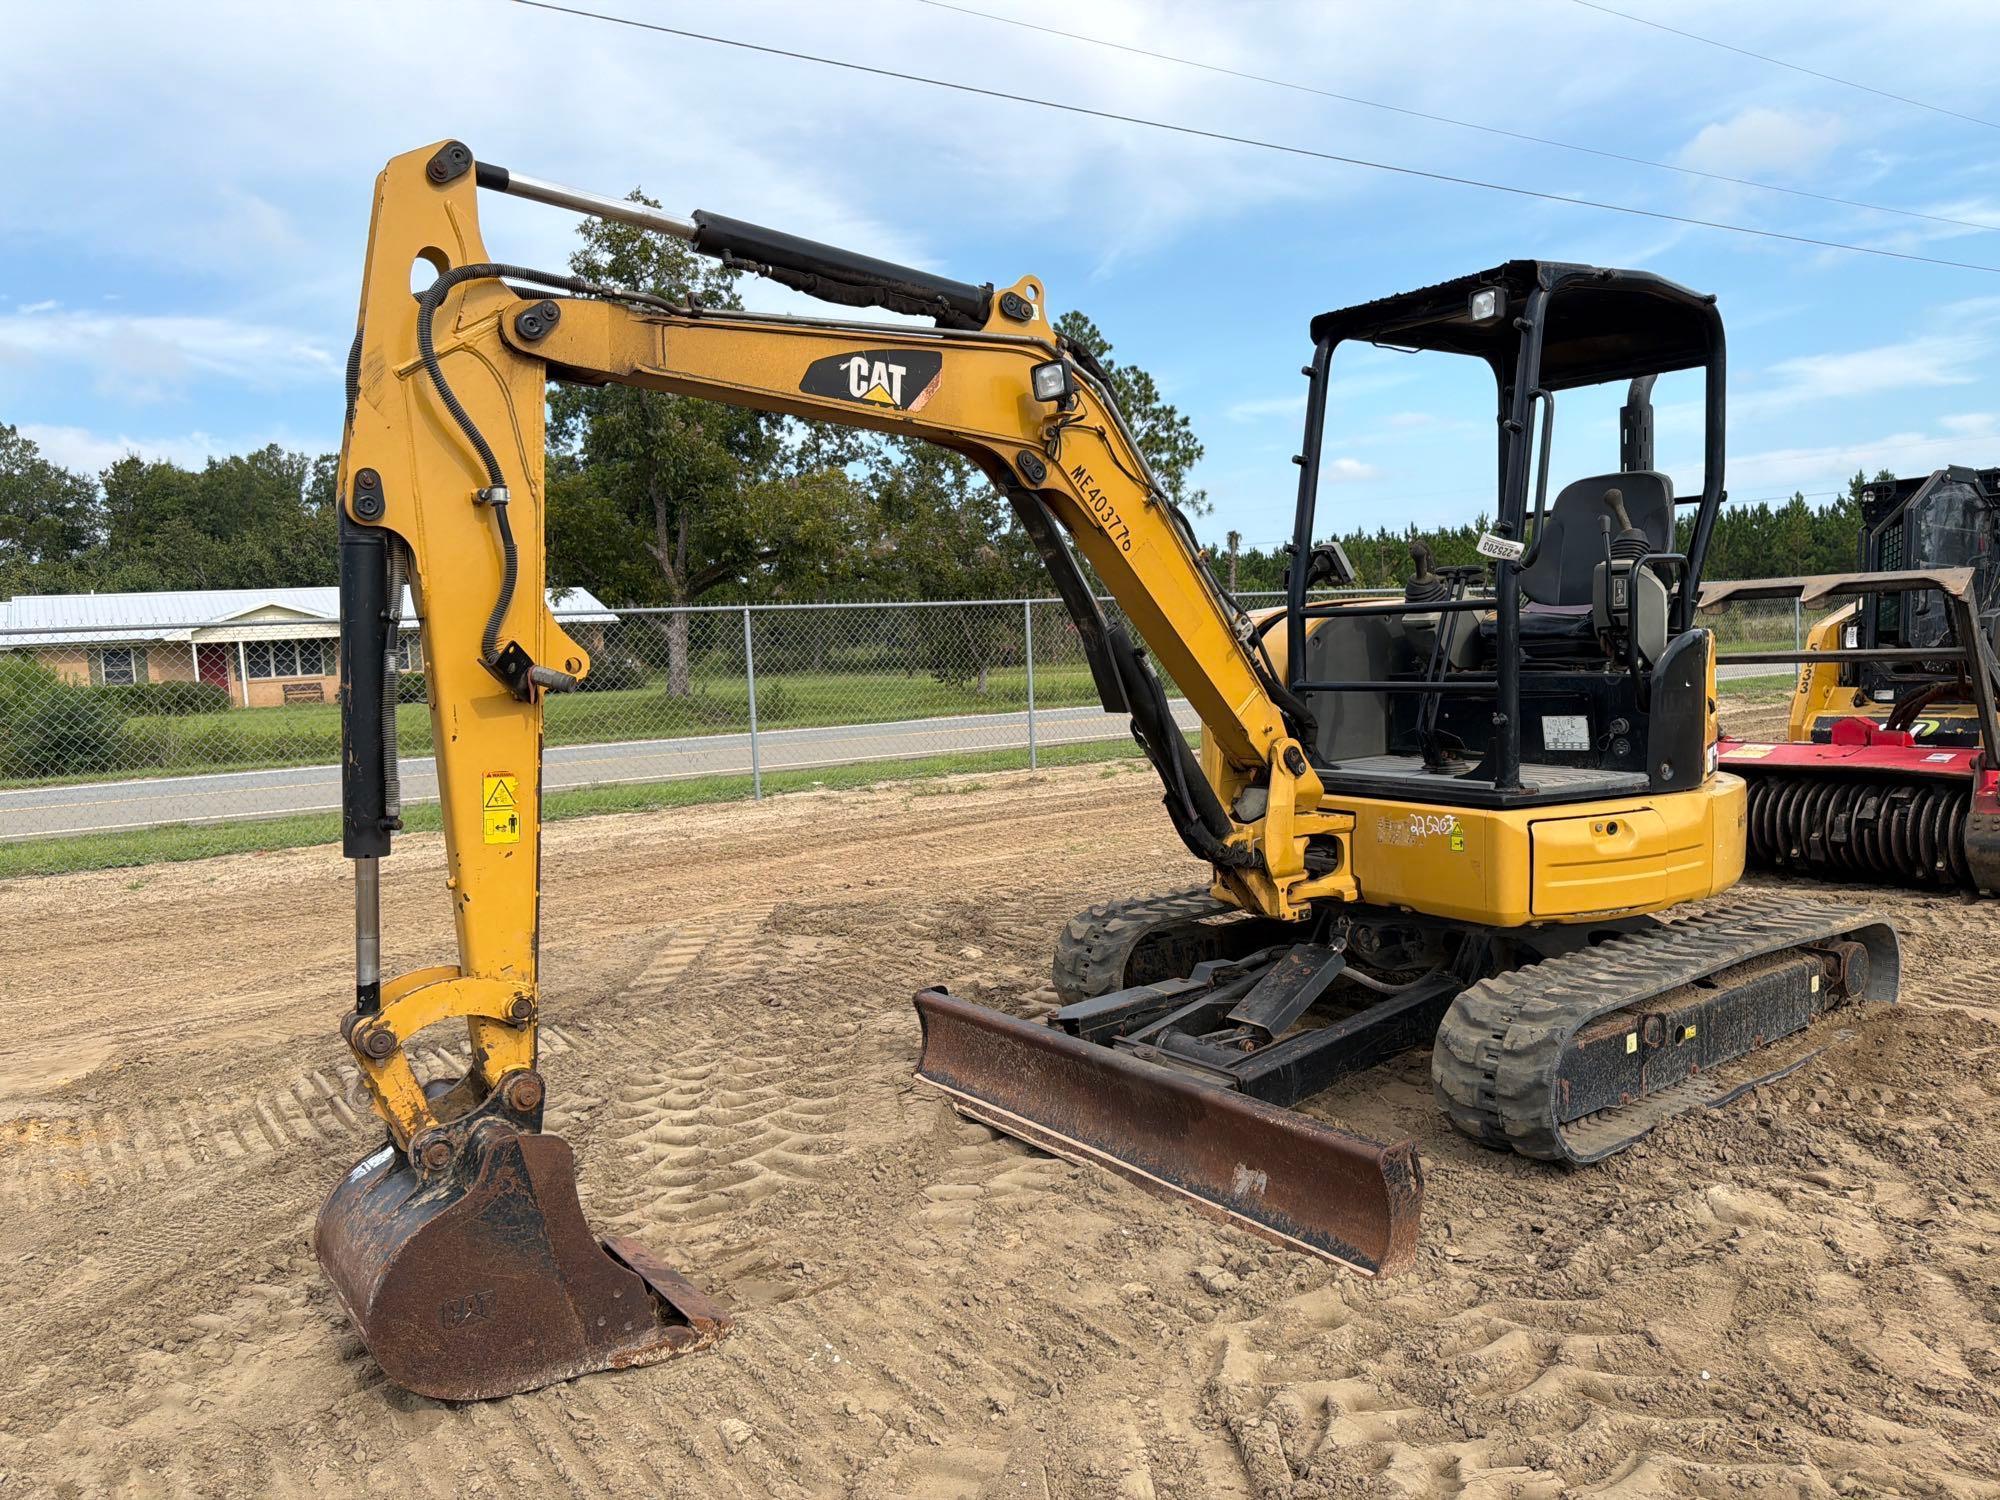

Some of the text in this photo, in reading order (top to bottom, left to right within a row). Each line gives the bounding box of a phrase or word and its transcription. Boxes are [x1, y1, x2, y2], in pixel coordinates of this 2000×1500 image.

[849, 356, 906, 405] CAT
[1482, 541, 1514, 557] 225203
[1410, 813, 1455, 838] 225203
